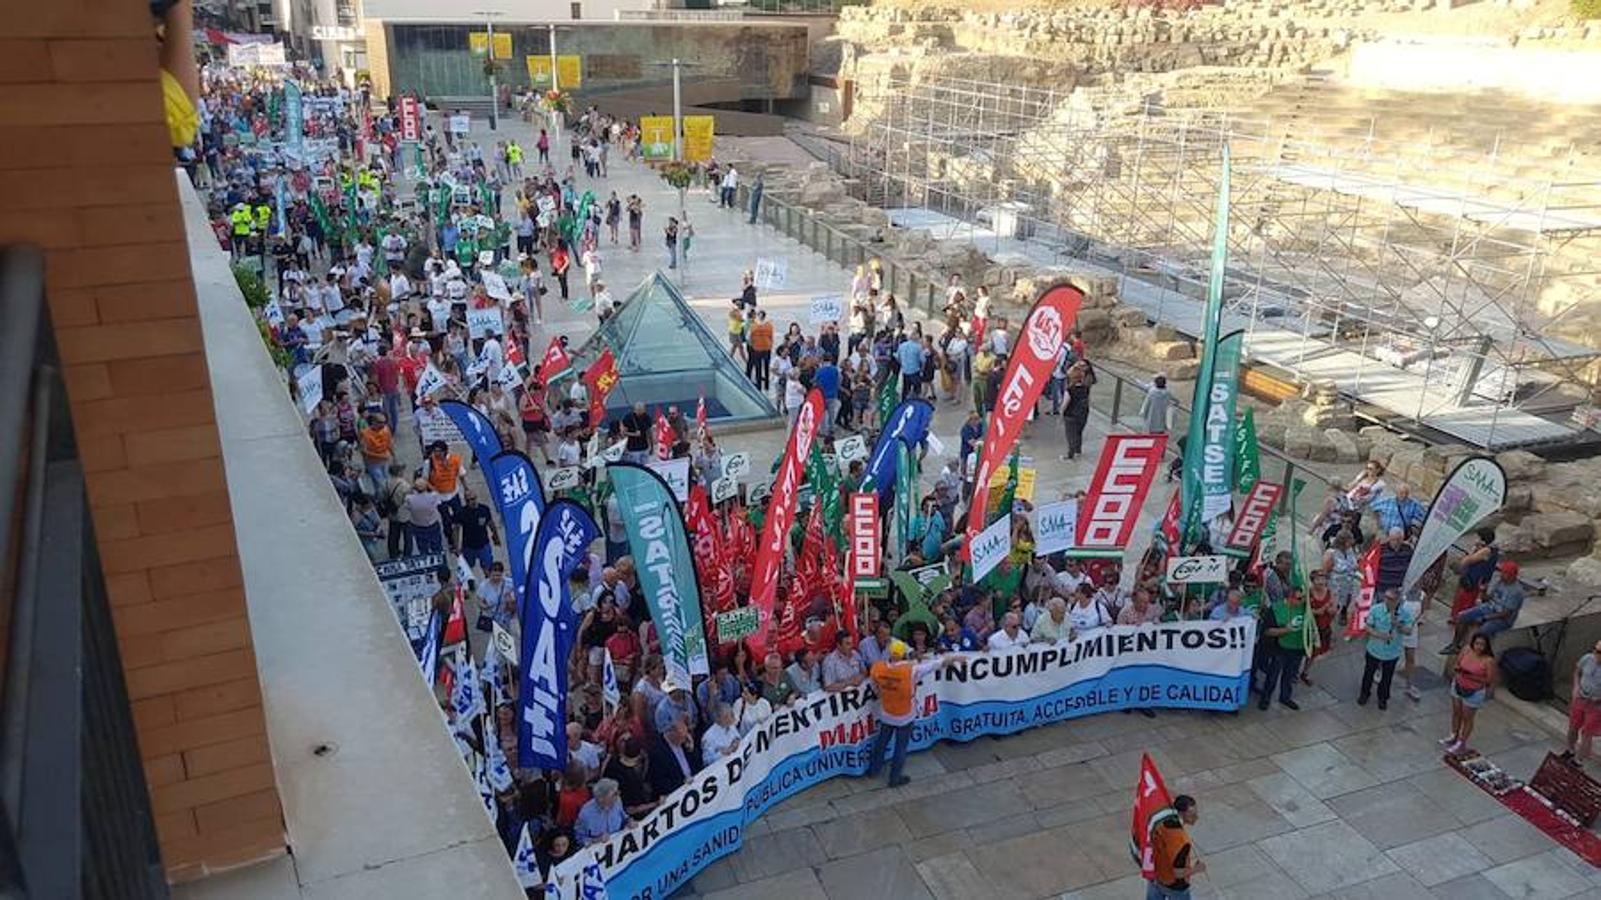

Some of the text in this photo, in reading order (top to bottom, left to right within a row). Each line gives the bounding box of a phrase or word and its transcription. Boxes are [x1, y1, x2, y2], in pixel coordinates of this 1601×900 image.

[1203, 383, 1229, 483] SATSE
[855, 497, 875, 575] CCOO
[1082, 438, 1155, 546] CCOO
[1231, 485, 1277, 546] CCOO
[755, 682, 878, 754] MENTIRA
[658, 861, 689, 894] UNA
[910, 718, 944, 743] GNA,
[1124, 685, 1134, 699] Y
[1139, 684, 1162, 700] DE
